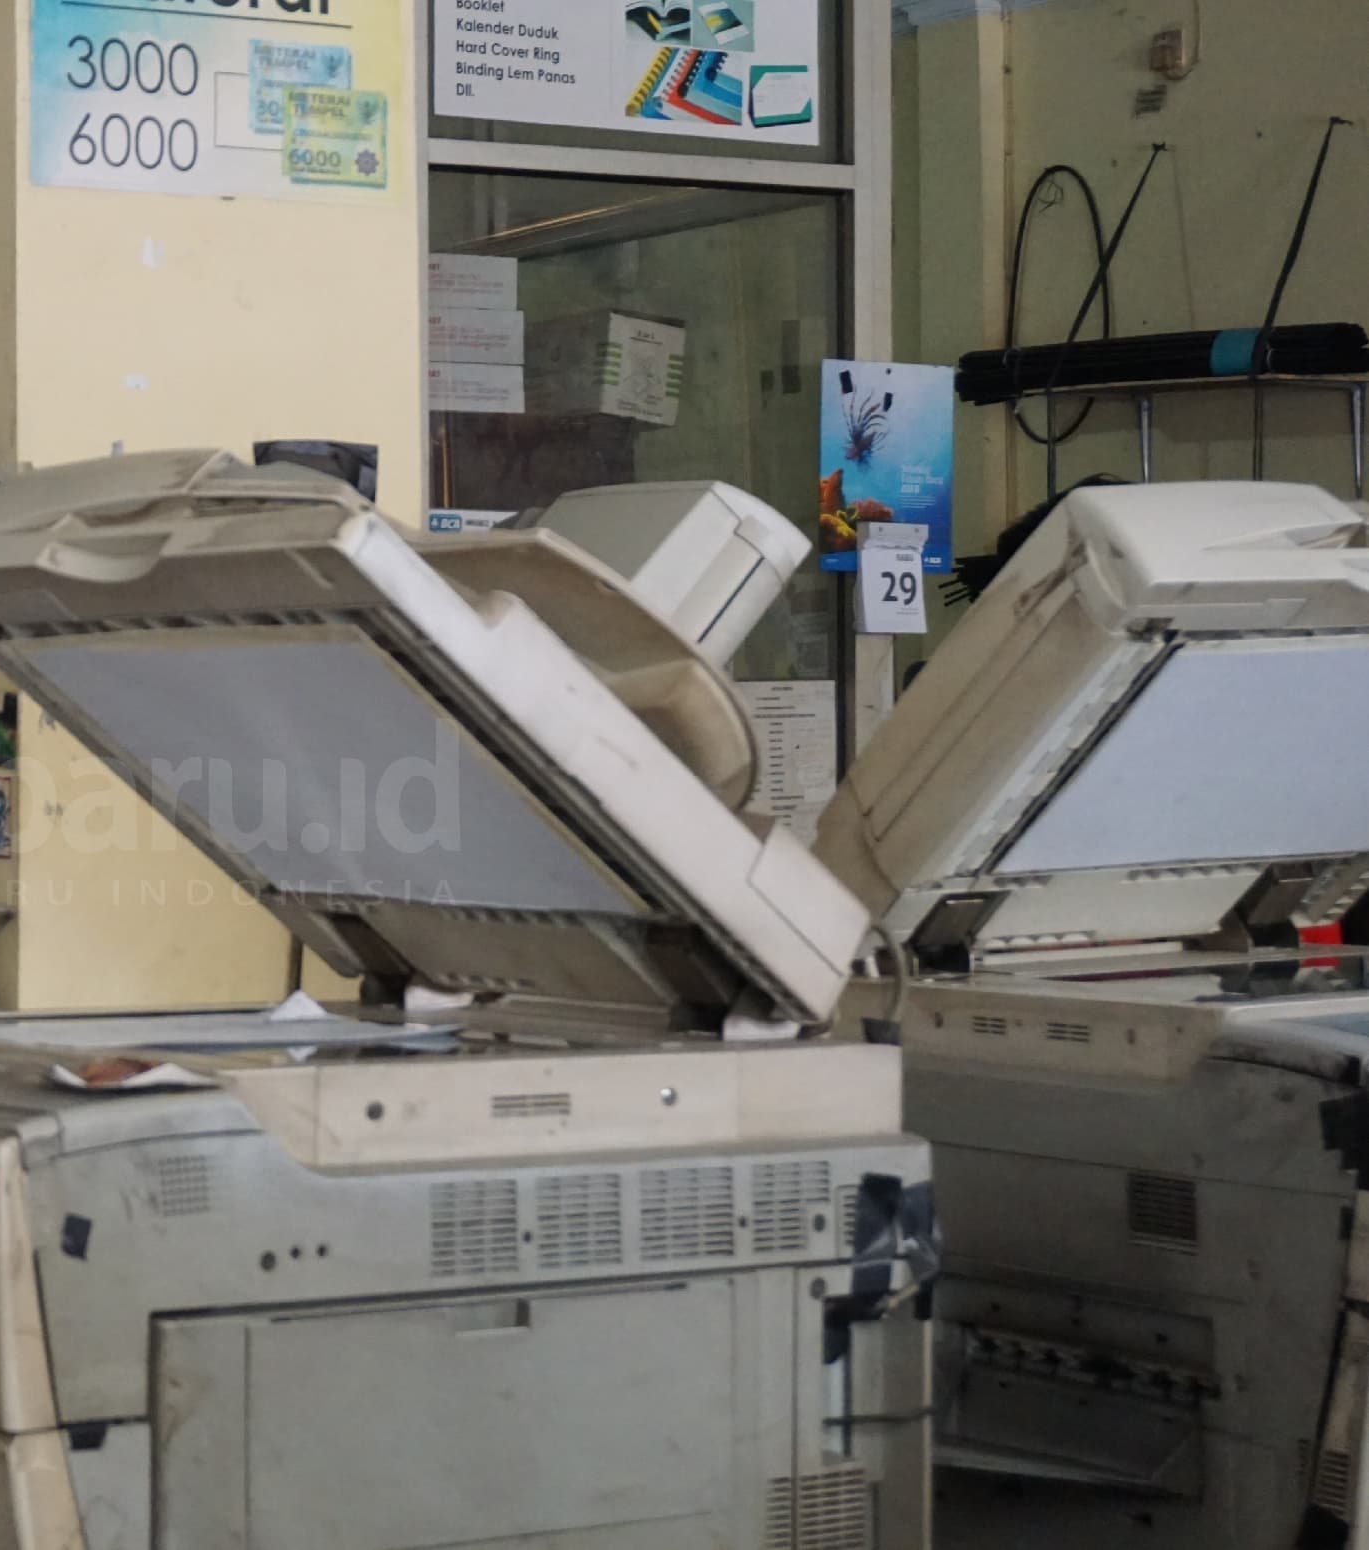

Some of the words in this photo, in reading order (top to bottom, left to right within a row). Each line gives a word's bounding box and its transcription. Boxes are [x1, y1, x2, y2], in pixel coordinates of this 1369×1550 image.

[456, 18, 514, 35] Kalender
[518, 24, 559, 40] Duduk
[456, 40, 487, 55] Hard
[491, 42, 529, 59] Cover
[533, 47, 560, 64] Ring
[67, 34, 199, 96] 3000
[456, 62, 504, 81] Binding
[508, 66, 534, 81] Lem
[538, 69, 576, 84] Panas
[456, 83, 475, 97] Dll.
[68, 112, 199, 172] 6000
[881, 571, 917, 606] 29
